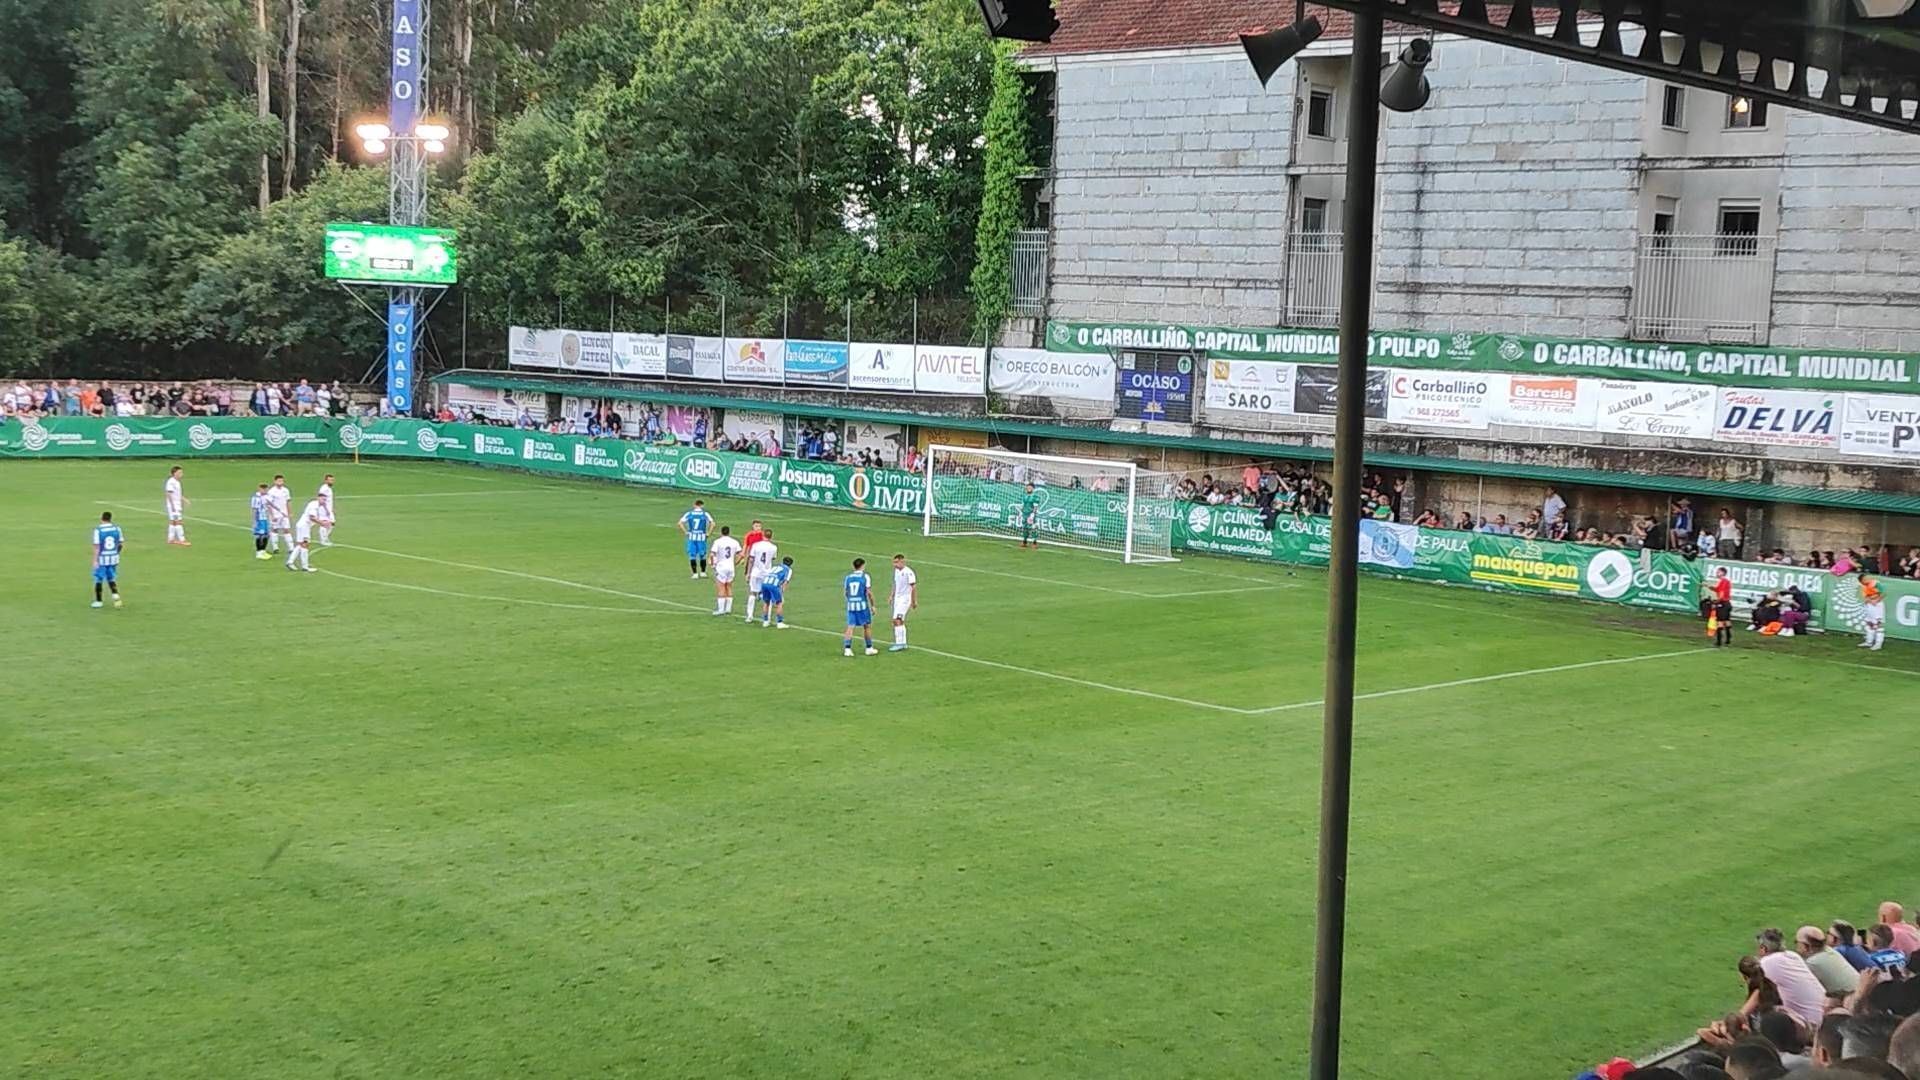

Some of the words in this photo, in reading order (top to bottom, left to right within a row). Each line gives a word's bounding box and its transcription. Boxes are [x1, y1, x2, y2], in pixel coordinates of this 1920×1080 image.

[395, 0, 415, 99] ASO
[1078, 328, 1088, 345] O
[1195, 331, 1261, 352] CAPITAL
[1380, 337, 1440, 358] PULPO
[393, 323, 407, 407] OCASO
[917, 353, 981, 375] AVATEL
[1006, 360, 1048, 374] ORECO
[1533, 342, 1549, 363] O
[1553, 344, 1691, 376] CARBALLIÑO,
[1697, 351, 1792, 377] CAPITAL
[1798, 356, 1911, 382] MUNDIAL
[1132, 373, 1181, 390] OCASO
[1228, 392, 1271, 410] SARO
[1514, 385, 1573, 400] Barcala
[1892, 425, 1920, 449] P
[534, 441, 555, 451] XUNTA
[586, 447, 607, 457] XUNTA
[686, 459, 721, 480] ABRIL
[873, 470, 941, 490] Gimnaso
[1139, 504, 1153, 516] DE
[1222, 509, 1264, 528] CLÍNIC
[693, 518, 700, 529] 7
[1279, 520, 1314, 537] CASAL
[104, 535, 115, 550] 8
[1216, 525, 1273, 544] ALAMEDA
[724, 546, 731, 559] 3
[1432, 537, 1470, 553] PAULA
[760, 552, 766, 564] 4
[849, 582, 860, 596] 17
[1633, 569, 1691, 593] COPE
